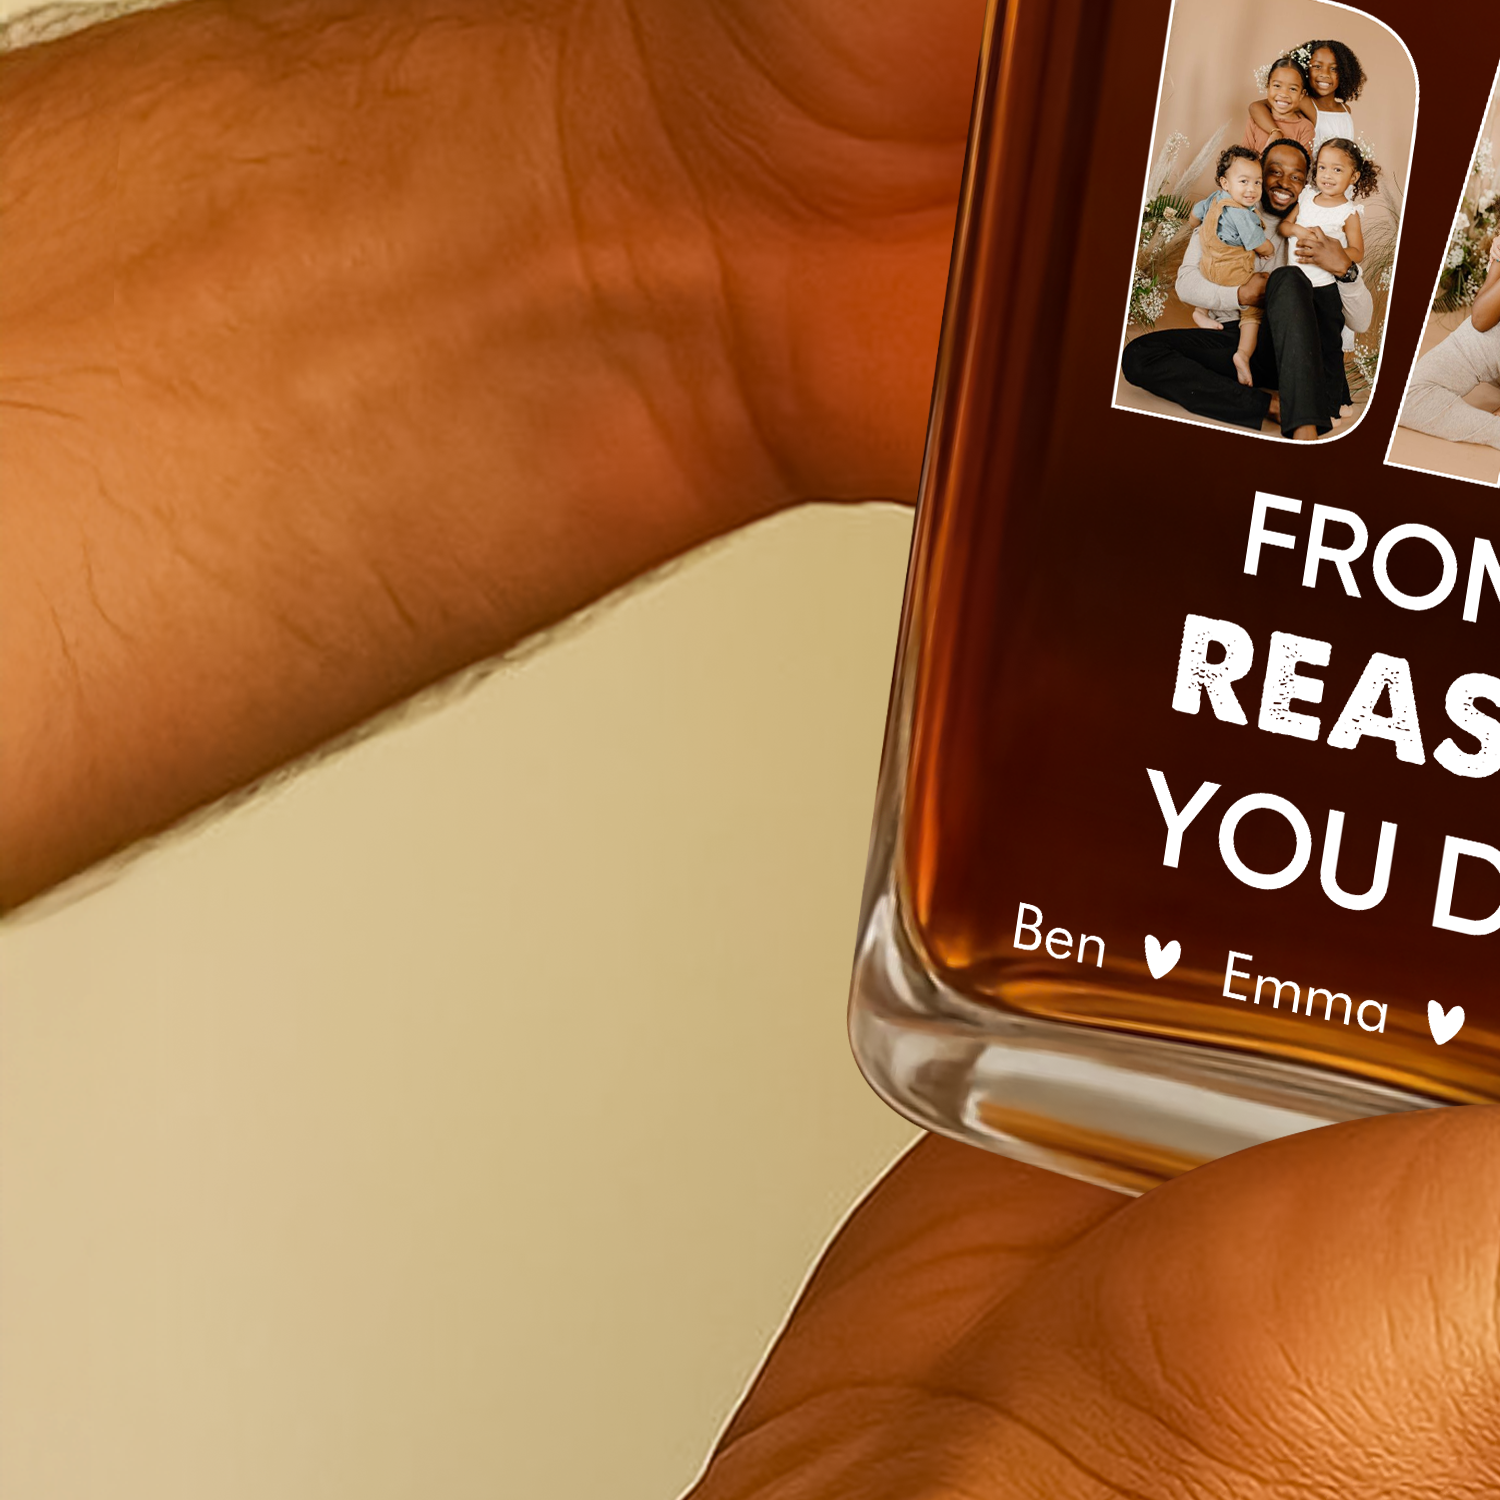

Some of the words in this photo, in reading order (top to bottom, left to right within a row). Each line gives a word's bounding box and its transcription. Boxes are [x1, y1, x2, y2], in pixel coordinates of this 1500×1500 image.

[1146, 767, 1398, 911] YOU
[1012, 901, 1106, 969] Ben
[1222, 950, 1390, 1034] Emma
